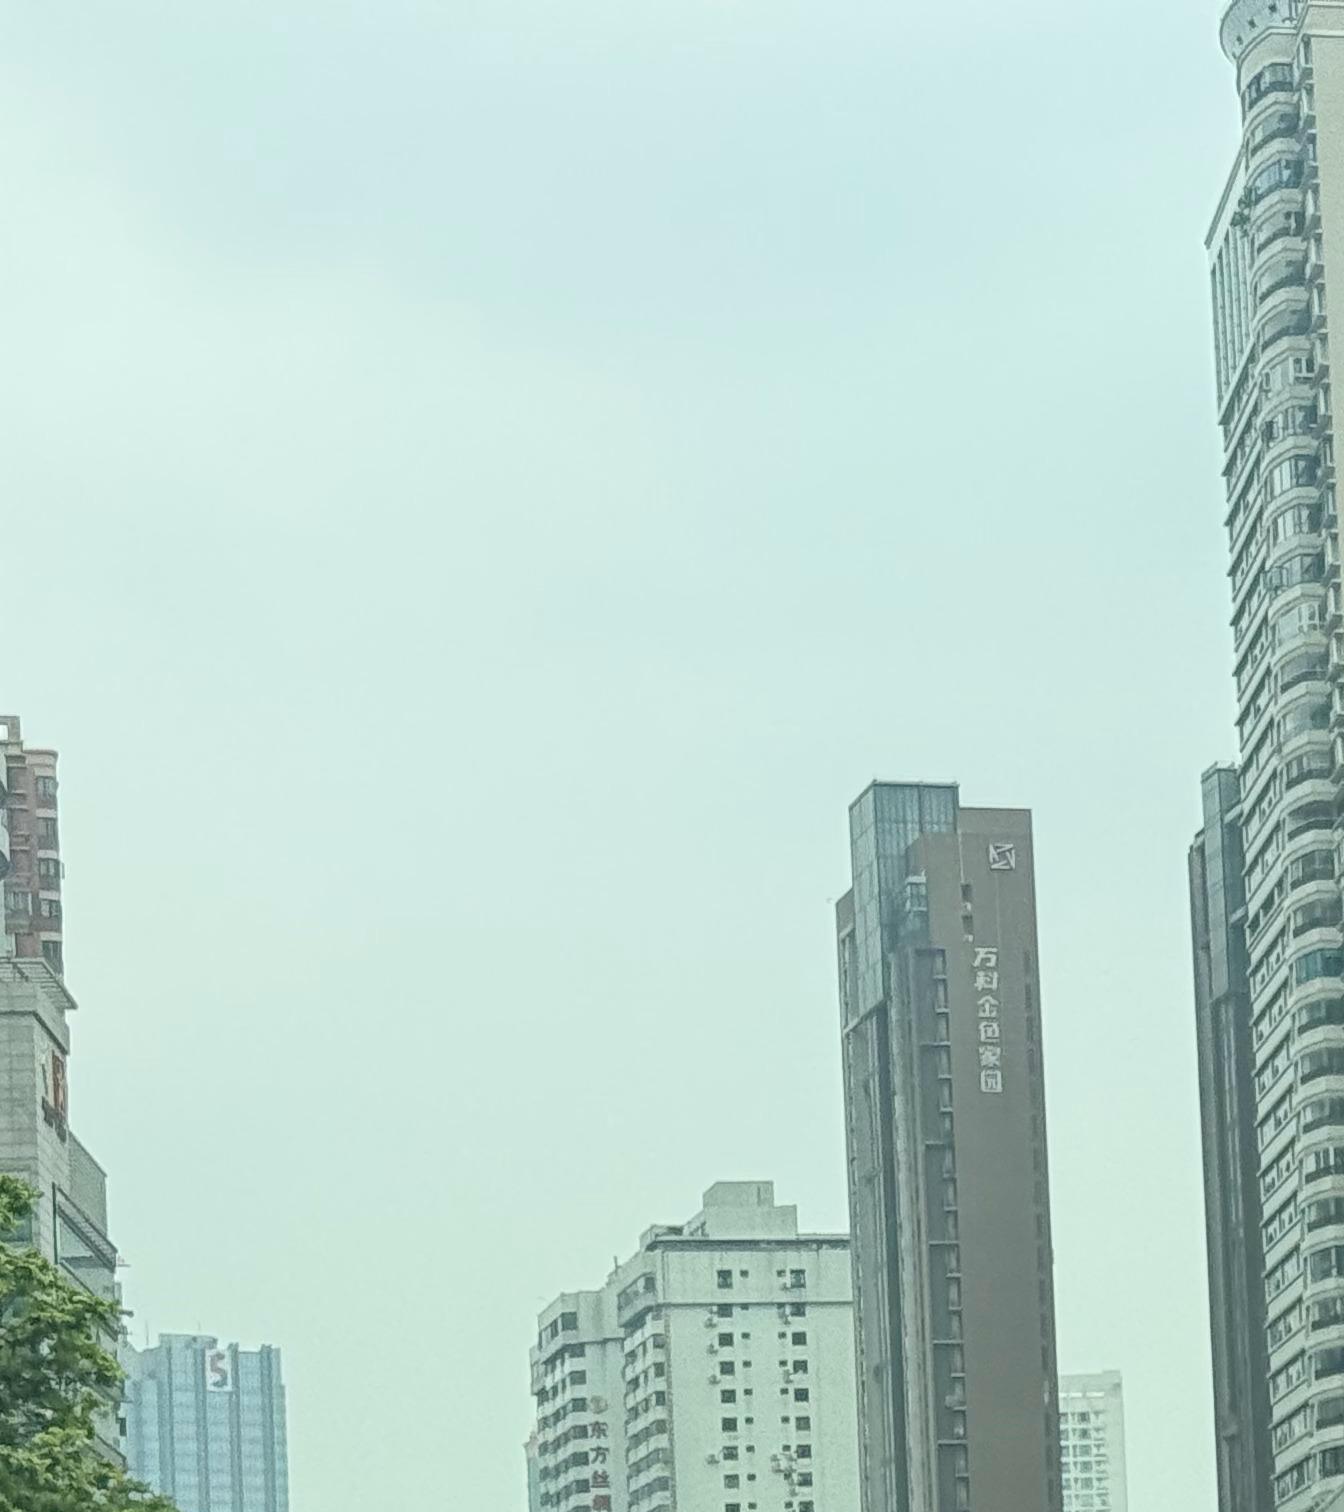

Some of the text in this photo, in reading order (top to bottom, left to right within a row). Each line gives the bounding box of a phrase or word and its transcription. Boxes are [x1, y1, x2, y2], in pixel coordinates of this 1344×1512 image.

[972, 946, 1003, 1094] 万科金色家园
